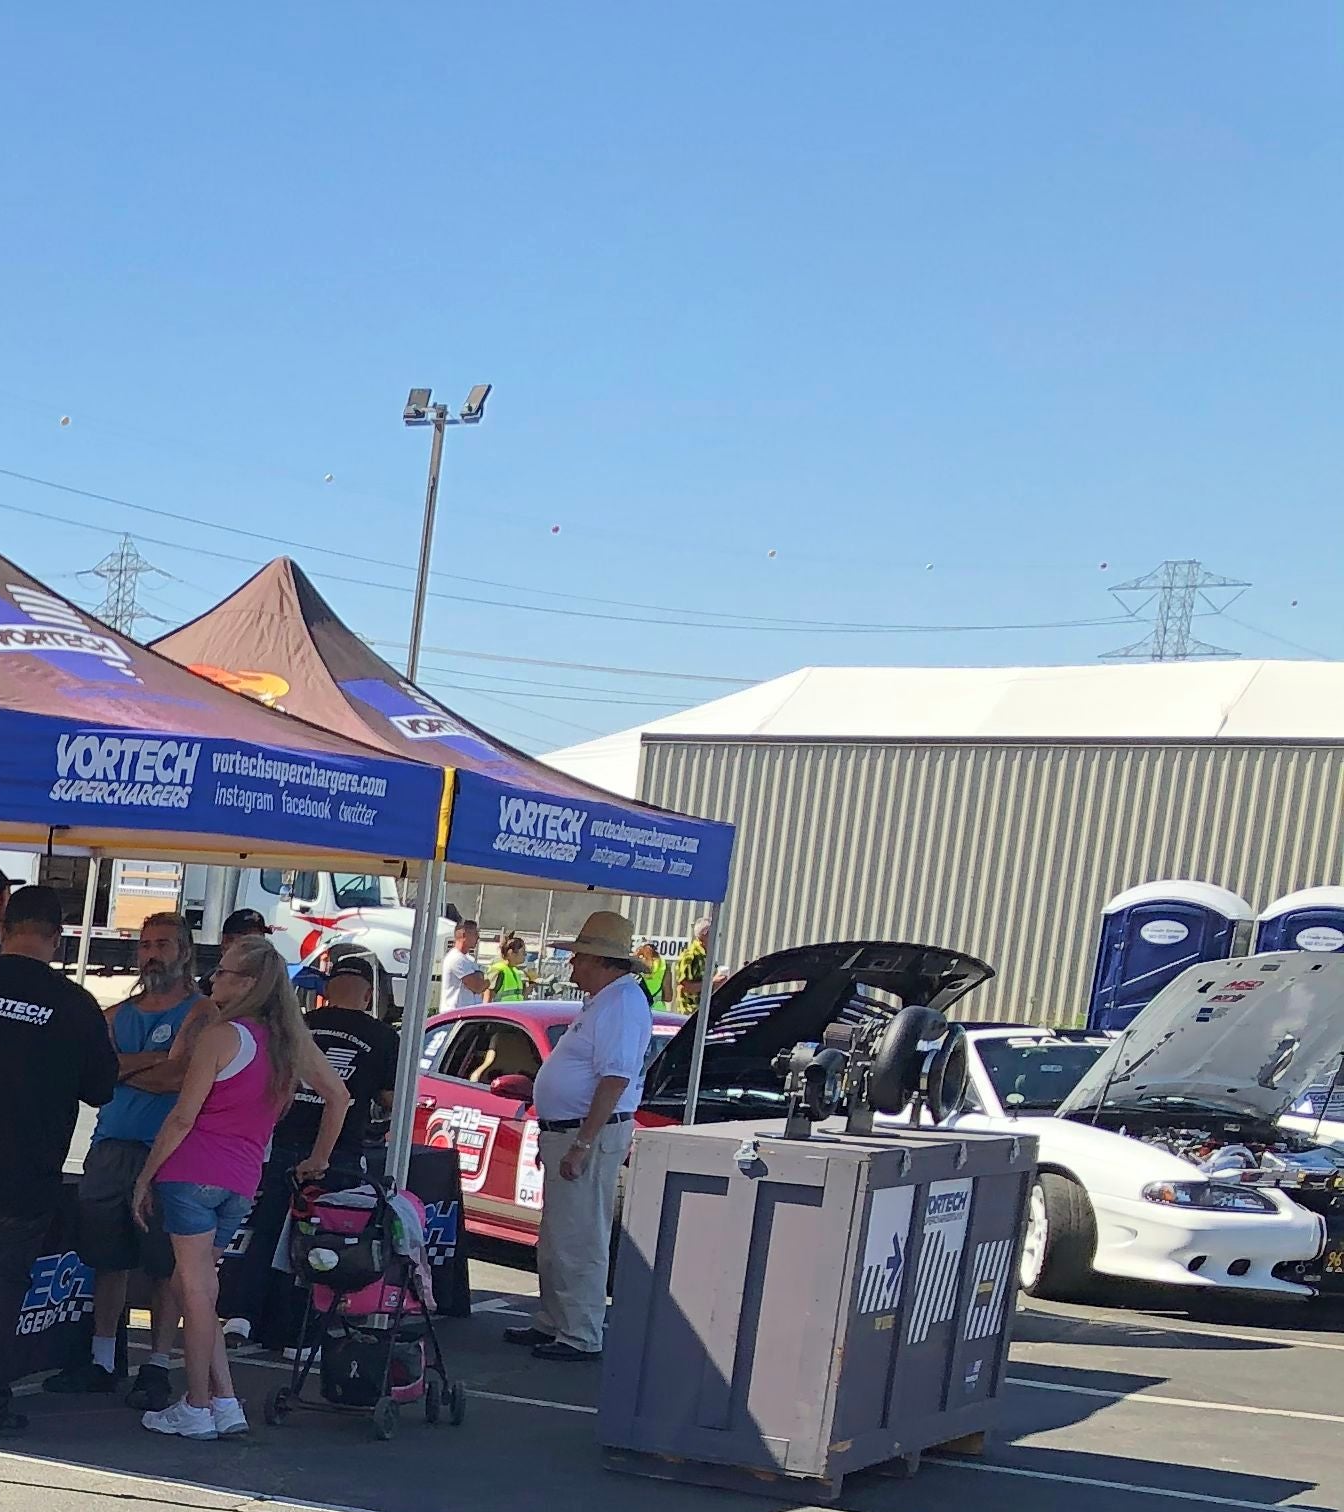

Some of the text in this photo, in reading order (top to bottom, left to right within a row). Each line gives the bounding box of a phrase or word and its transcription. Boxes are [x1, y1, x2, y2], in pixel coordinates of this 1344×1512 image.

[56, 734, 201, 785] VORTECH
[212, 751, 387, 797] vortechsuperchargers.com
[48, 779, 193, 809] SUPERCHARGERS
[215, 781, 378, 826] instagram facebook twitter
[498, 796, 588, 844] VORTECH
[492, 833, 582, 863] SUPERCHARGERS
